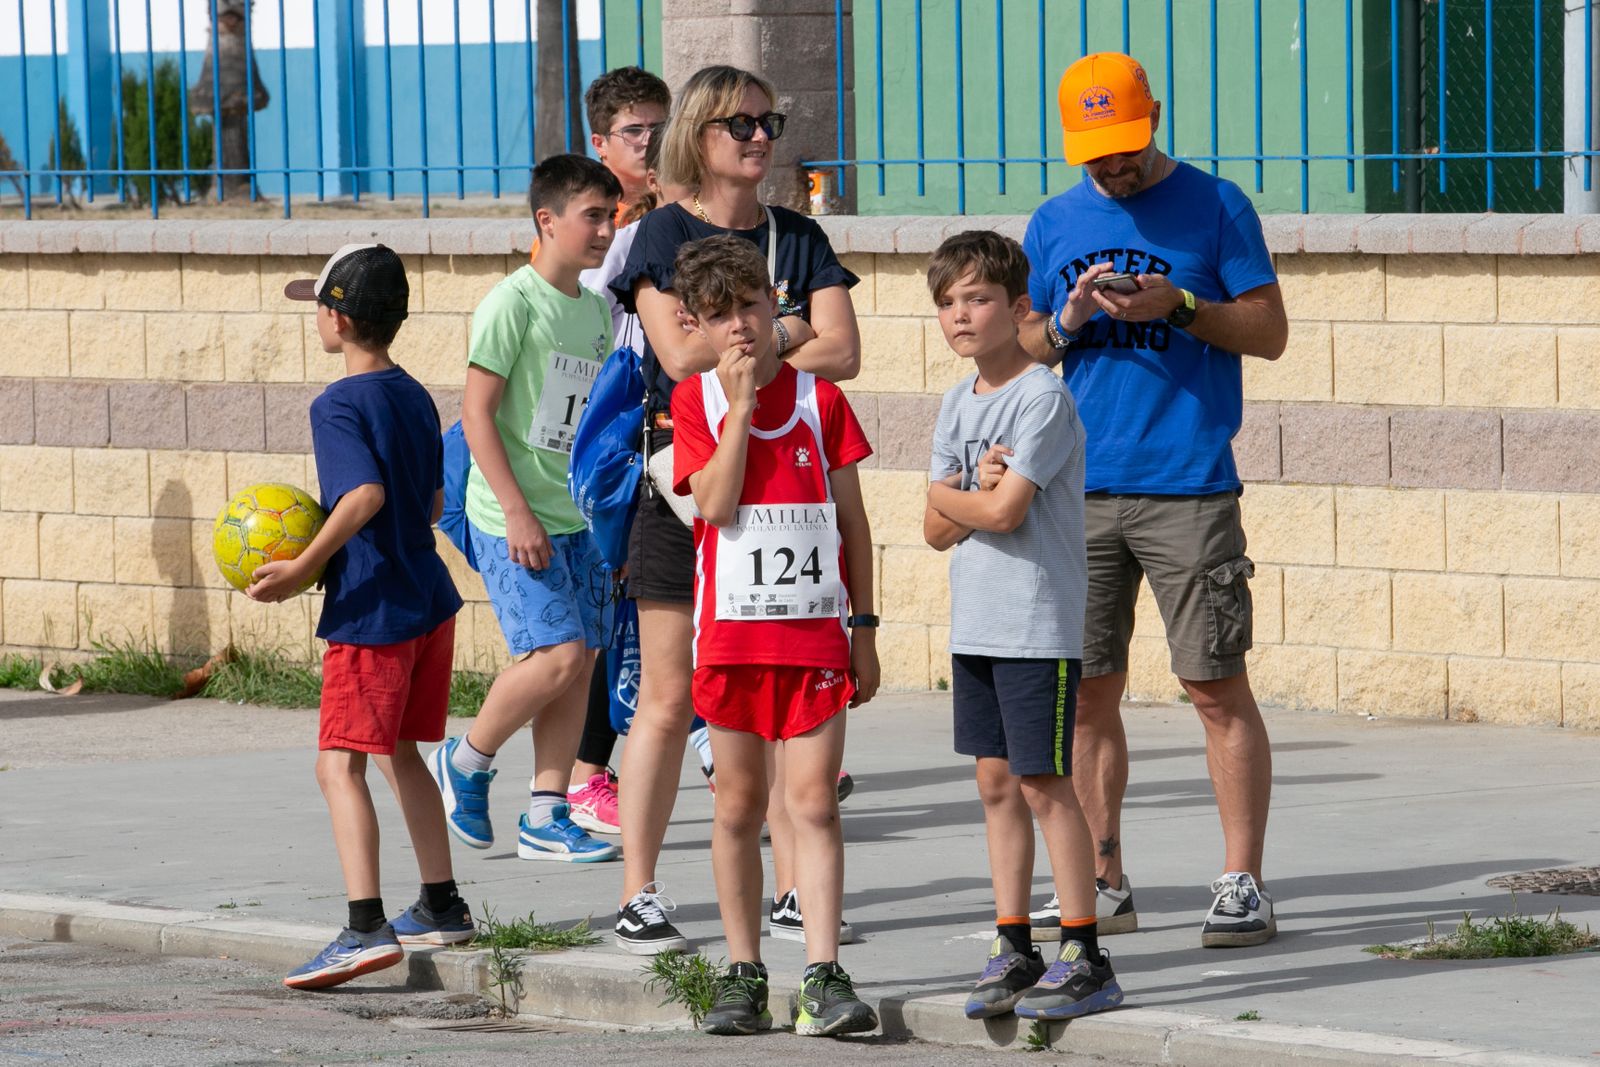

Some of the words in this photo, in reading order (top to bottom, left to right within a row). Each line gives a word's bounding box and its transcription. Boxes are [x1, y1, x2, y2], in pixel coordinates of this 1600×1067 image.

[554, 356, 568, 371] II
[752, 508, 828, 525] MILLA
[747, 546, 823, 586] 124
[814, 676, 844, 691] KELME
